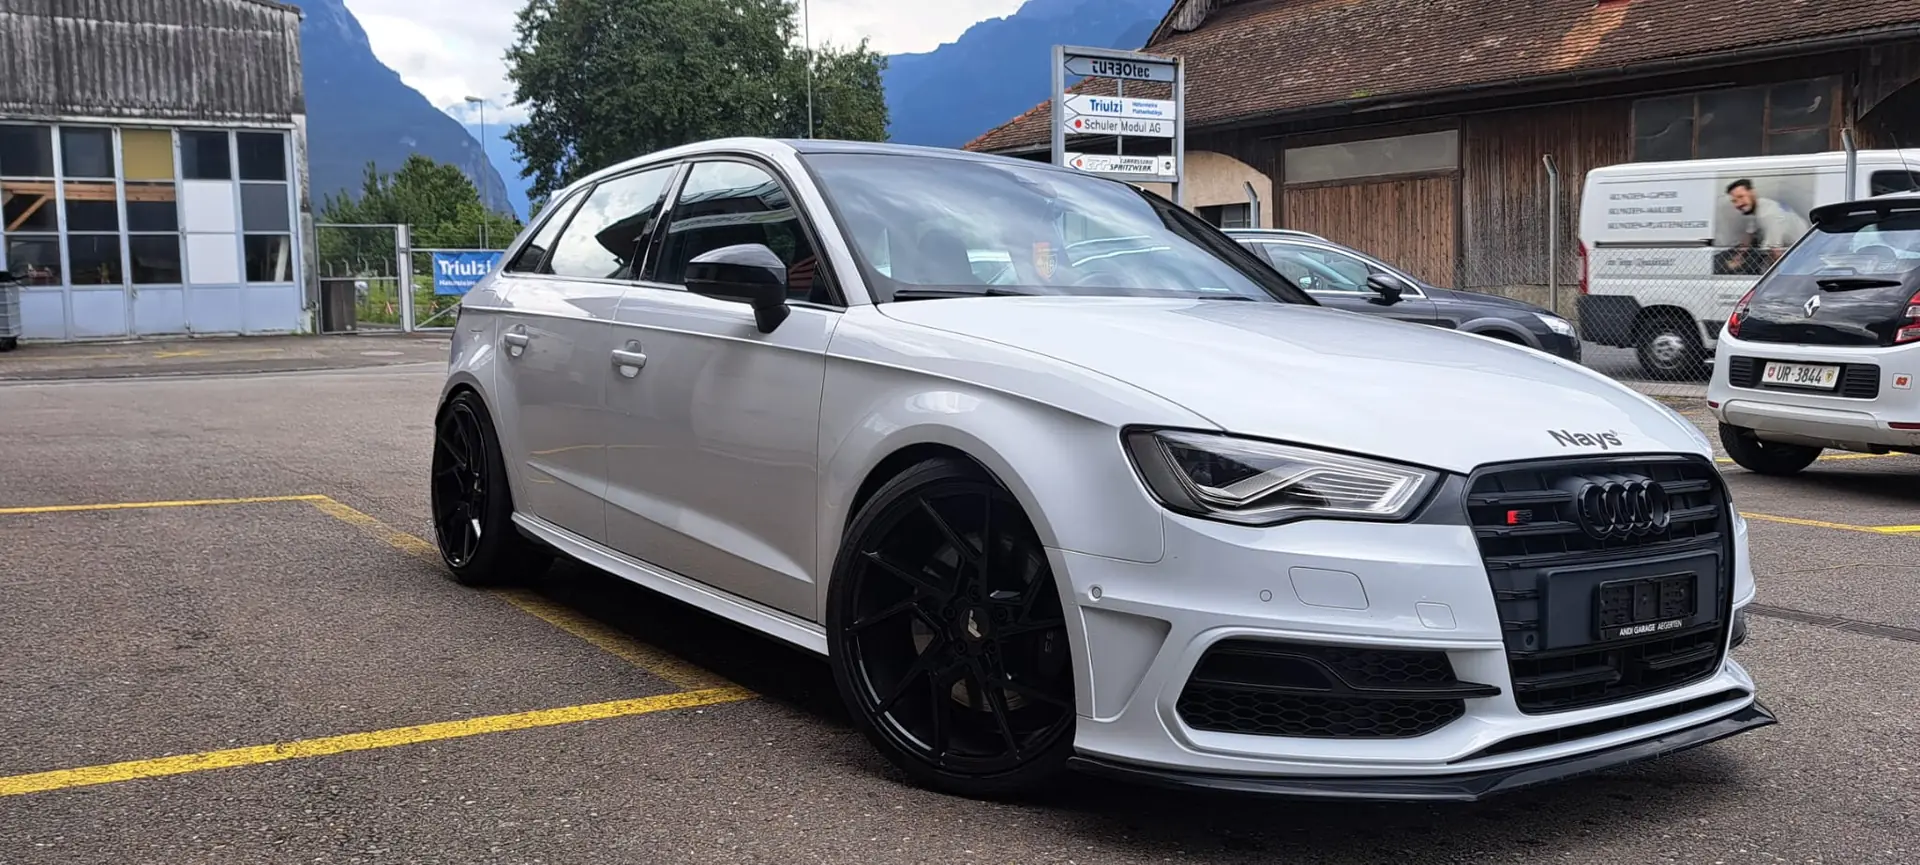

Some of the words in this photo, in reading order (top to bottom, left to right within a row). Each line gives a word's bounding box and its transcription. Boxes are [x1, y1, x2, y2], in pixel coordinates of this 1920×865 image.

[1089, 99, 1123, 113] Triulzi
[1084, 119, 1118, 131] Schuler
[1121, 121, 1147, 133] Modul
[1149, 123, 1161, 134] AG
[438, 260, 492, 276] Triulzi
[1619, 626, 1634, 637] ANDI
[1633, 623, 1656, 634] GARAGE
